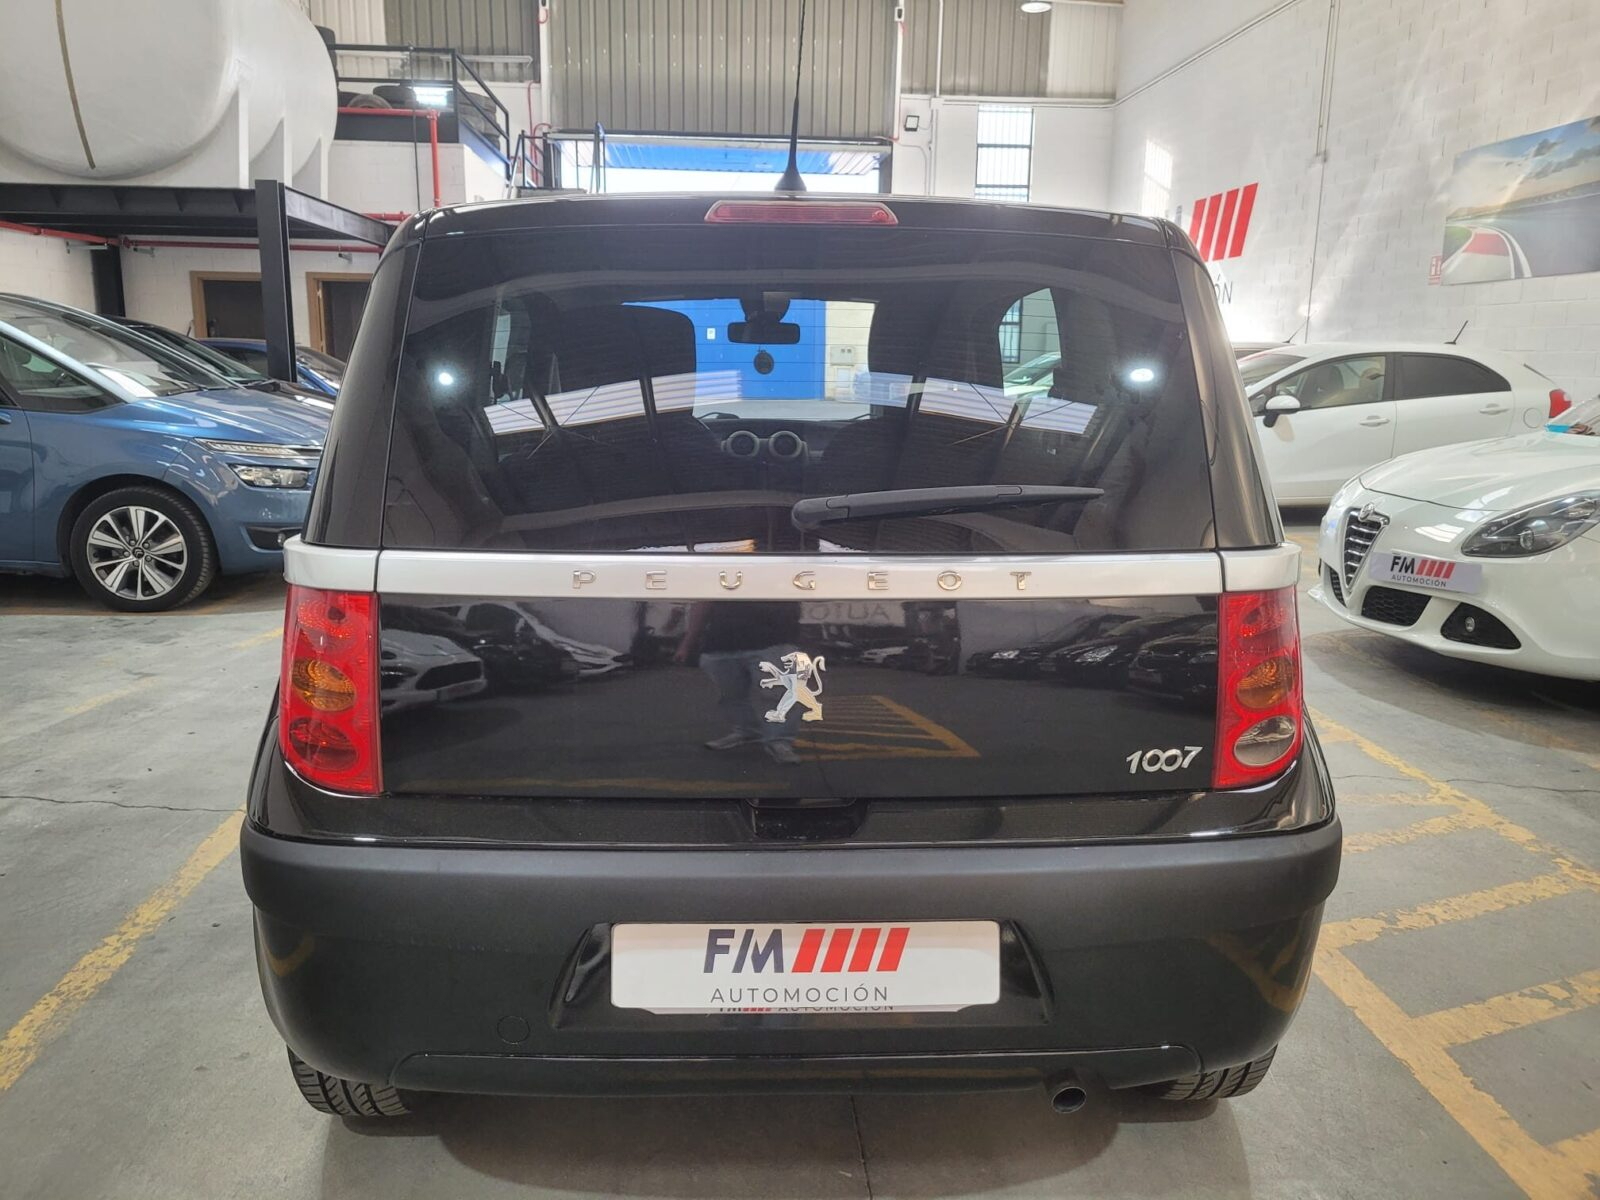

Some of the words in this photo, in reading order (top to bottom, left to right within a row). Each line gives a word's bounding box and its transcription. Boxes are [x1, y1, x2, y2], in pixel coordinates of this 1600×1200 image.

[1390, 555, 1416, 574] FM
[572, 570, 1033, 591] PEUGEOT
[1126, 745, 1203, 774] 1007
[703, 928, 785, 974] FM
[710, 983, 888, 1004] AUTOMOCIÓN
